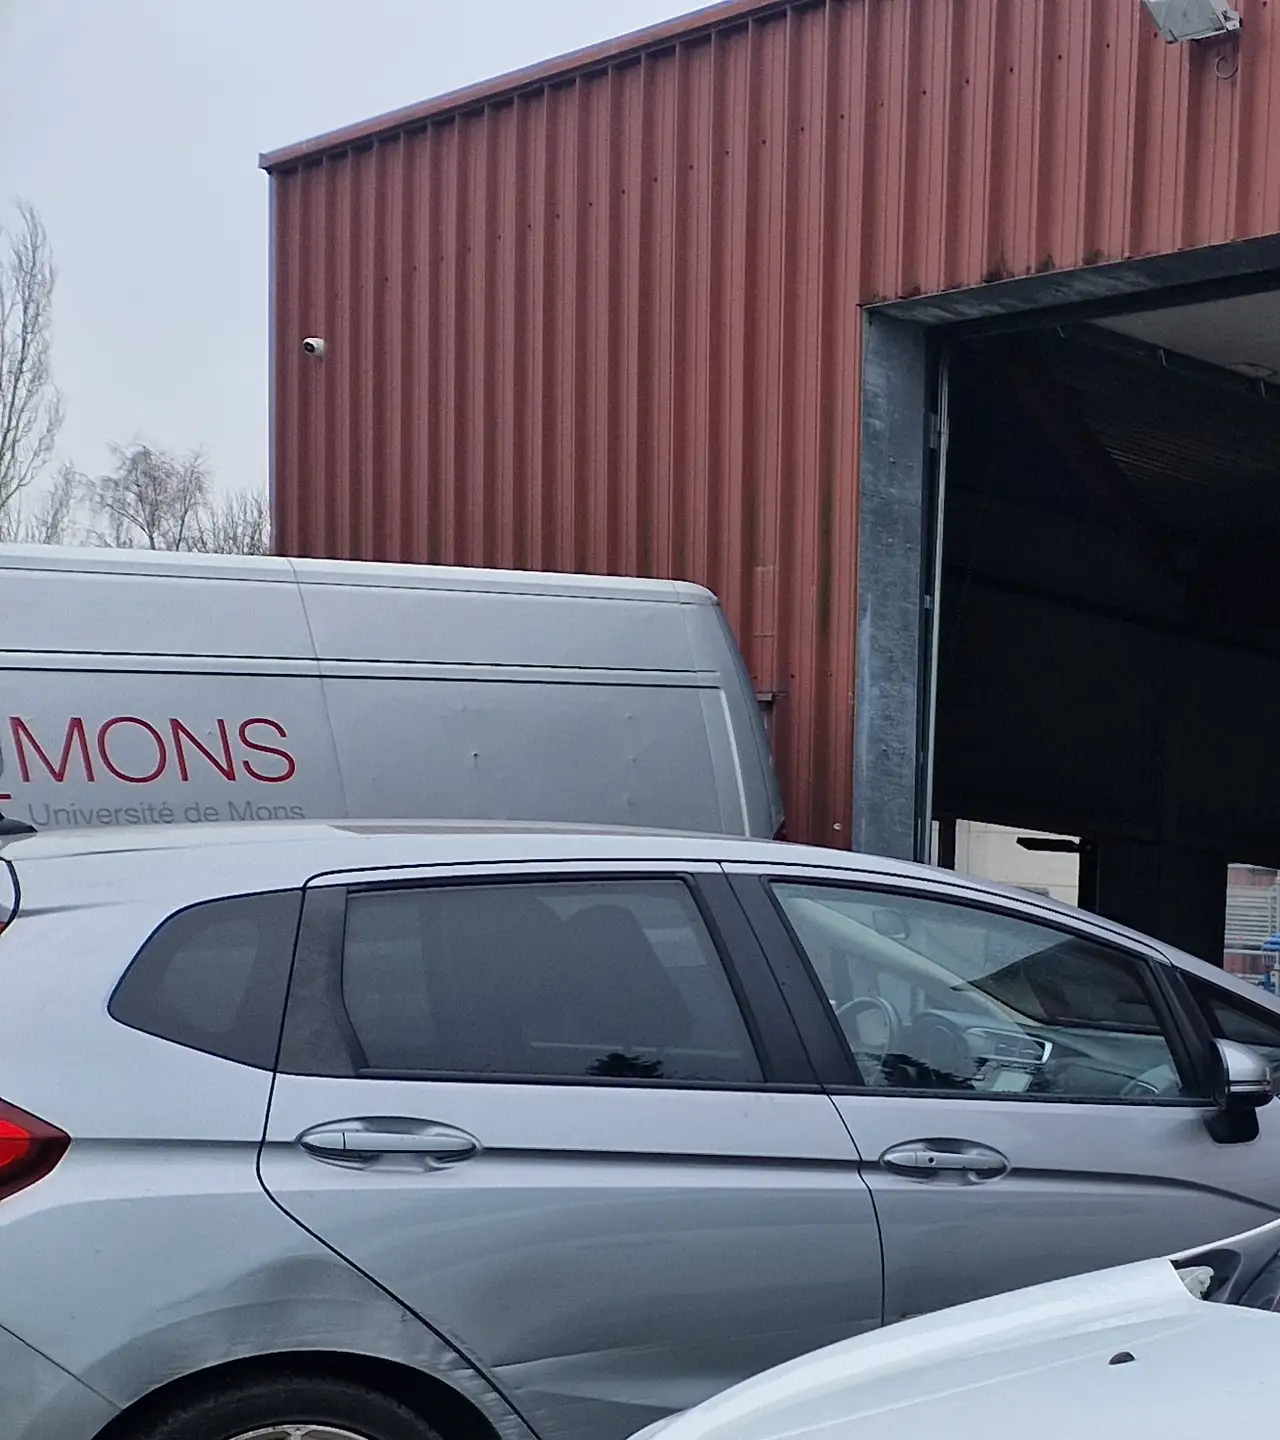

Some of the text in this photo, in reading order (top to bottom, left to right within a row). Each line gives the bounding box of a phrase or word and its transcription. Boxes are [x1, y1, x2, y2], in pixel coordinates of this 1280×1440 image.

[0, 716, 296, 784] MONS
[27, 800, 306, 826] Université de Mons
